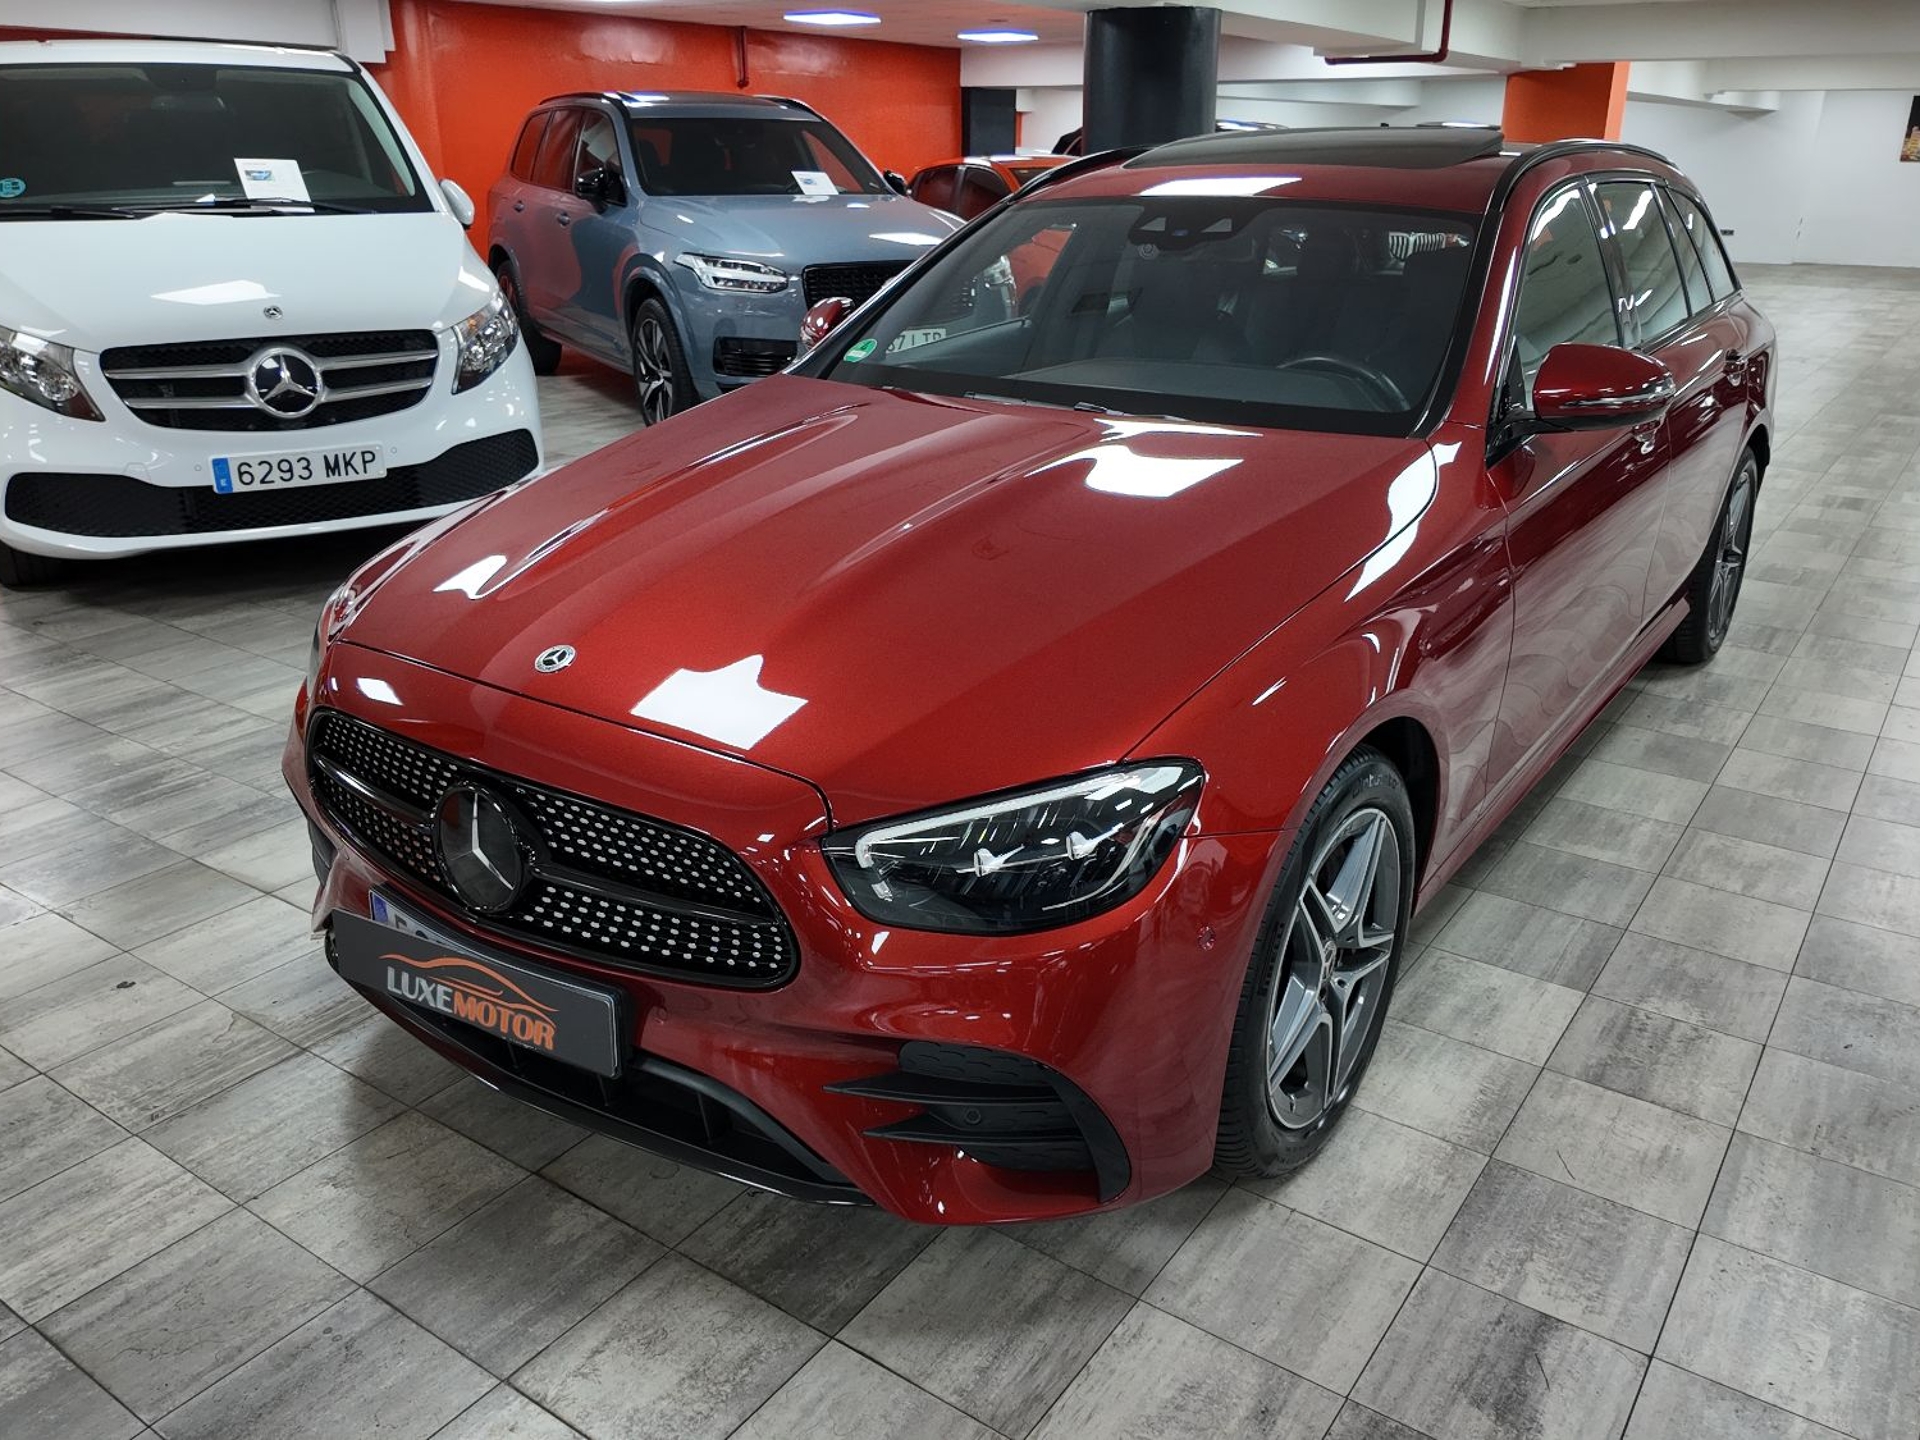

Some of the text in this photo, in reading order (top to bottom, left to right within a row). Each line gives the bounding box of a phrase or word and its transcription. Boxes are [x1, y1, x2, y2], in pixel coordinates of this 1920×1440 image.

[237, 450, 376, 486] 6293 MKP
[386, 966, 556, 1051] LUXEMOTOR
